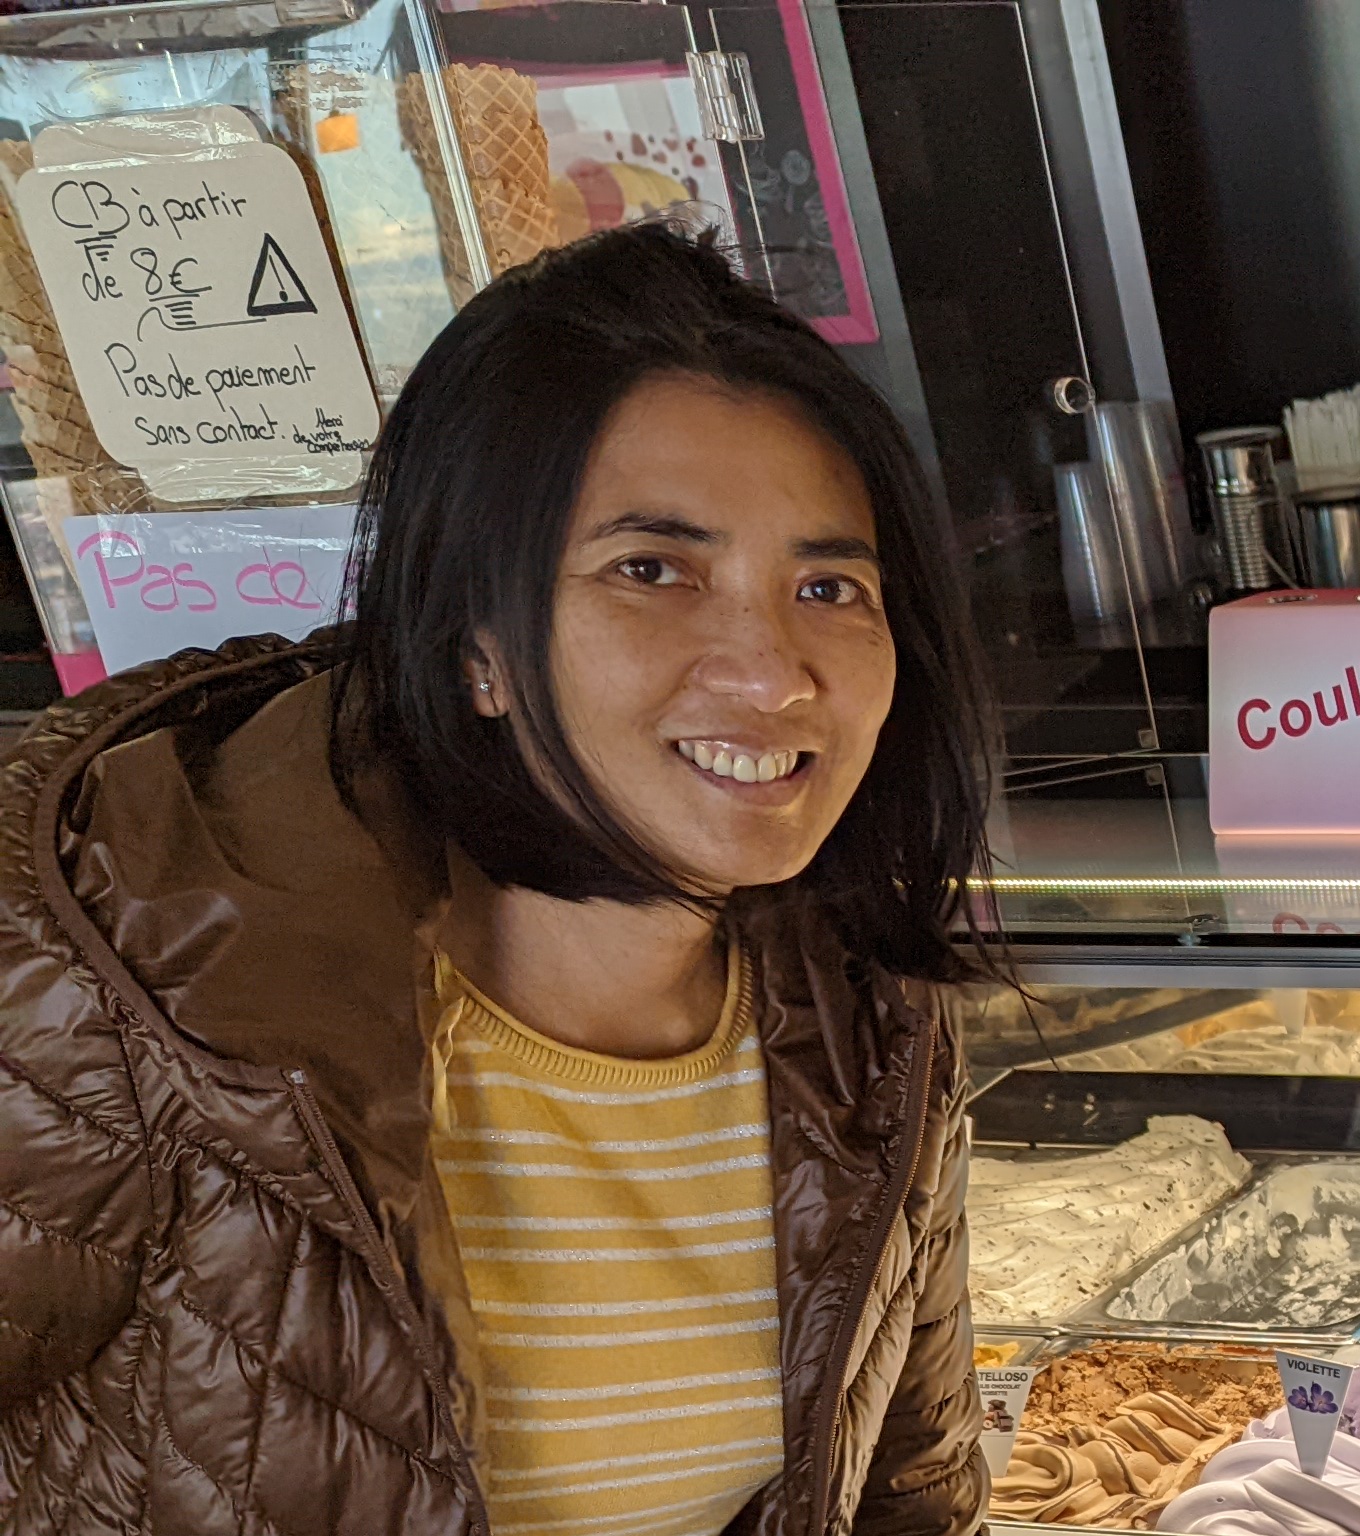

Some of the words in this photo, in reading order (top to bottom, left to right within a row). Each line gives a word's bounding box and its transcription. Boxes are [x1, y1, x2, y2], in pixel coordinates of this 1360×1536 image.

[51, 180, 131, 236] CB
[131, 186, 160, 227] à
[162, 180, 247, 241] partir
[82, 245, 123, 301] de
[130, 247, 213, 296] 8€
[103, 342, 168, 398] Pas
[167, 352, 201, 400] de
[205, 343, 317, 412] paiement
[76, 529, 218, 613] Pas
[235, 544, 322, 610] de
[978, 1371, 1029, 1382] TELLOSO
[1286, 1358, 1341, 1379] VIOLETTE
